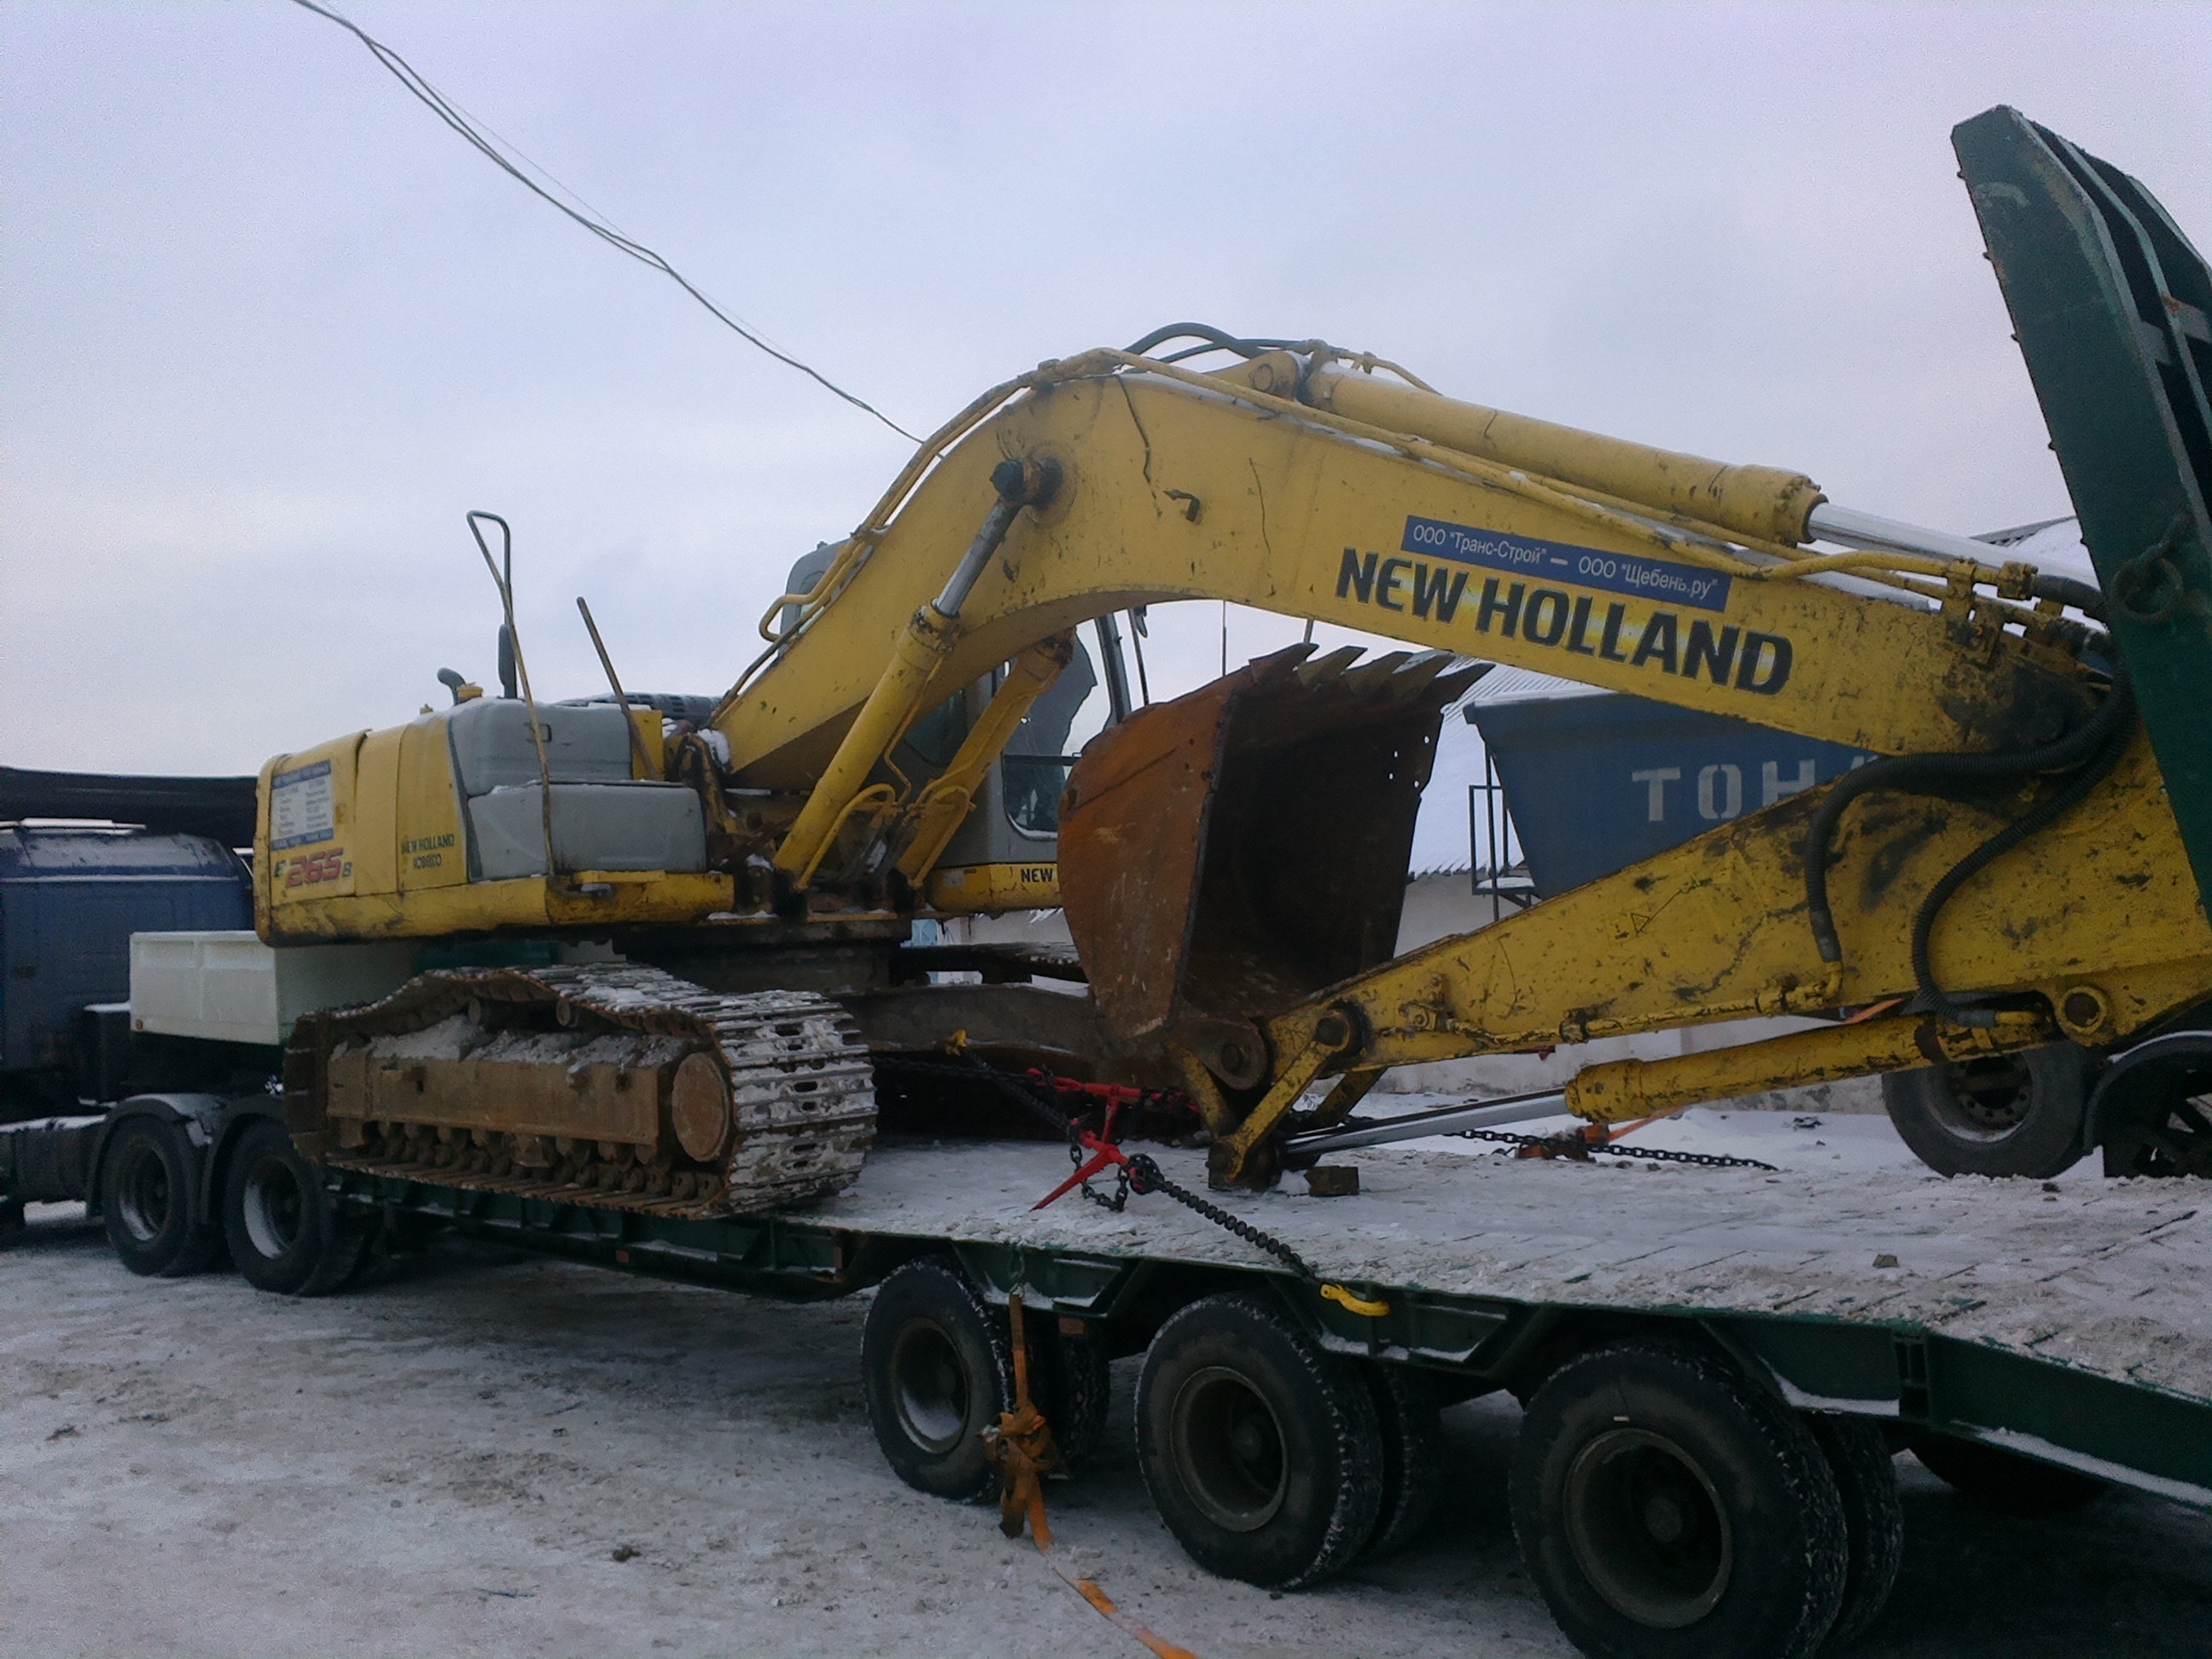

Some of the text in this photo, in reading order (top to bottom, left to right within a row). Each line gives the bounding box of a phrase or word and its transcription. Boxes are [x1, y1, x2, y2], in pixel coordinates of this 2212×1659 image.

[1413, 524, 1447, 545] ООО
[1579, 556, 1616, 579] ООО
[1336, 546, 1794, 696] NEW HOLLAND
[1632, 755, 1878, 822] ТОН
[1021, 868, 1053, 882] NEW
